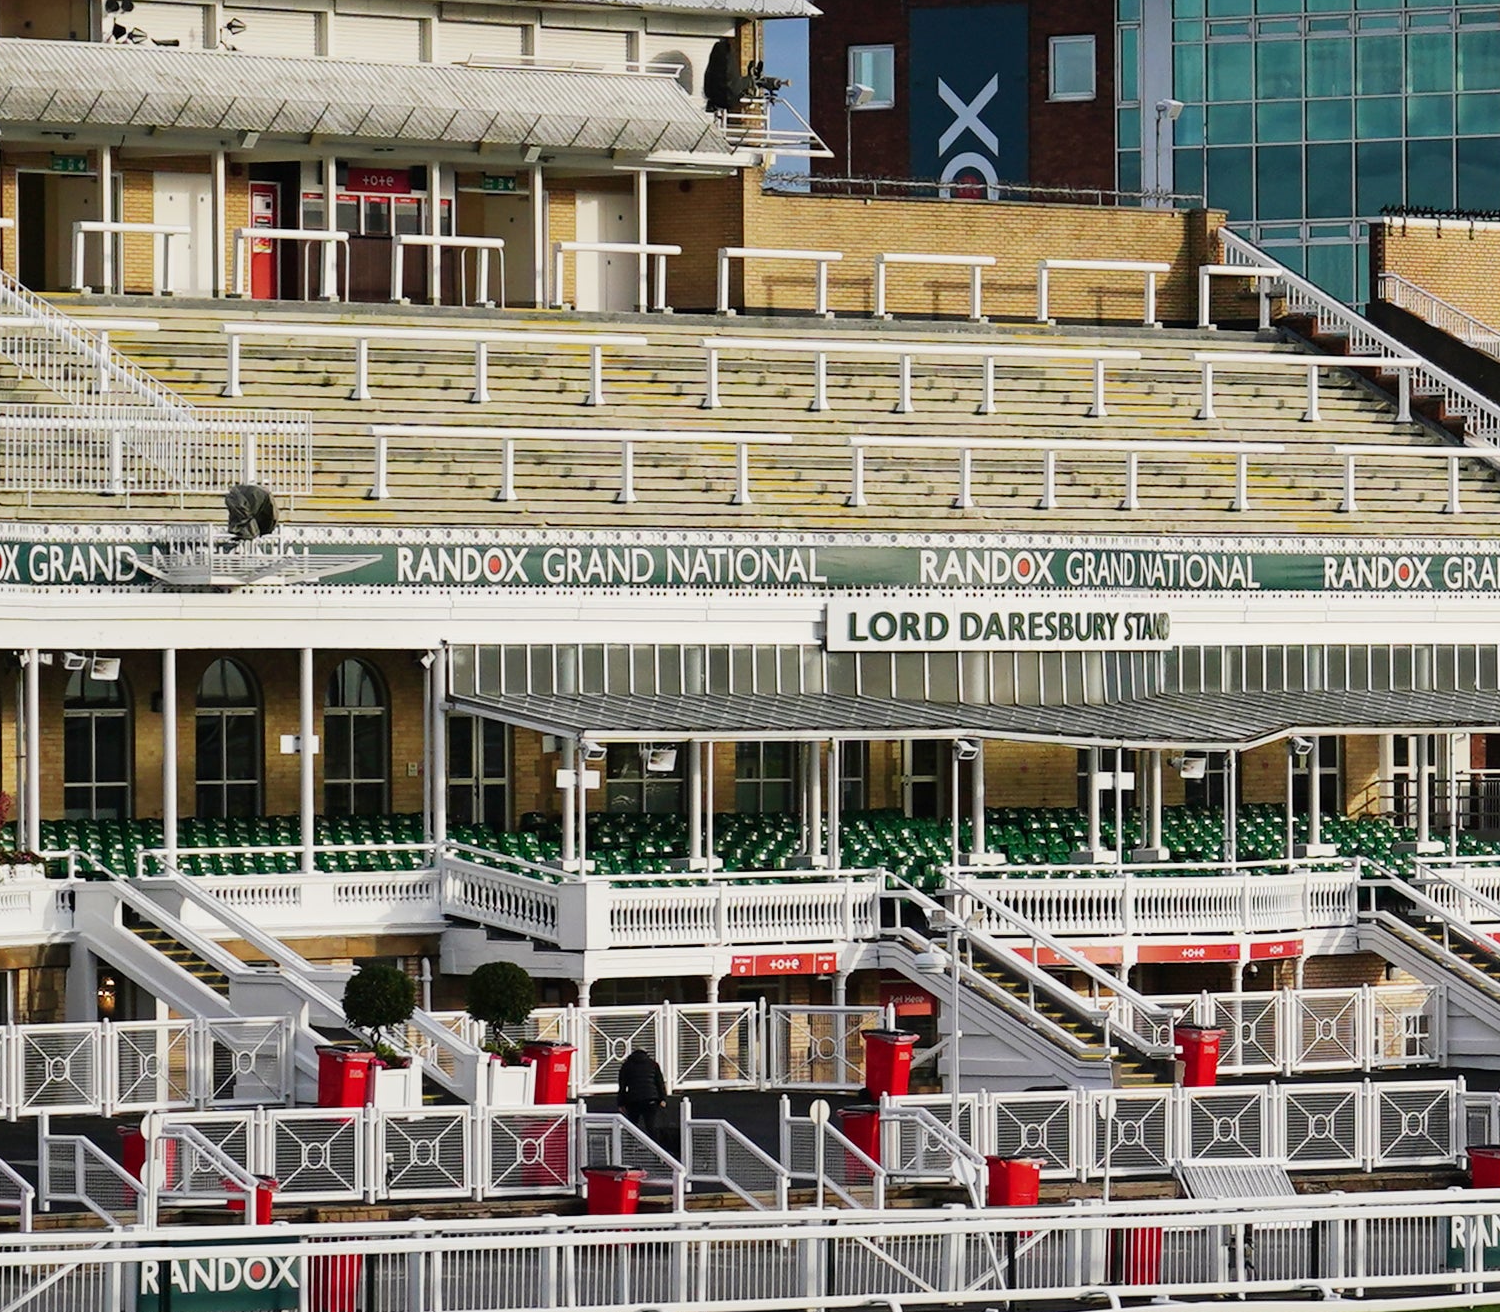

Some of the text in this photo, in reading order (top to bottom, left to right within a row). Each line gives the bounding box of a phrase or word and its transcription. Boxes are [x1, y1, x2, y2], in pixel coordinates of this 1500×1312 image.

[28, 544, 139, 583] GRAND
[397, 547, 827, 584] RANDOX GRAND NATIONAL
[919, 549, 1261, 589] RANDOX GRAND NATIONAL
[1323, 556, 1432, 589] RANDOX
[847, 611, 950, 642] LORD
[960, 611, 1120, 643] DARESBURY
[769, 956, 800, 970] tote
[140, 1255, 300, 1295] RANDOX
